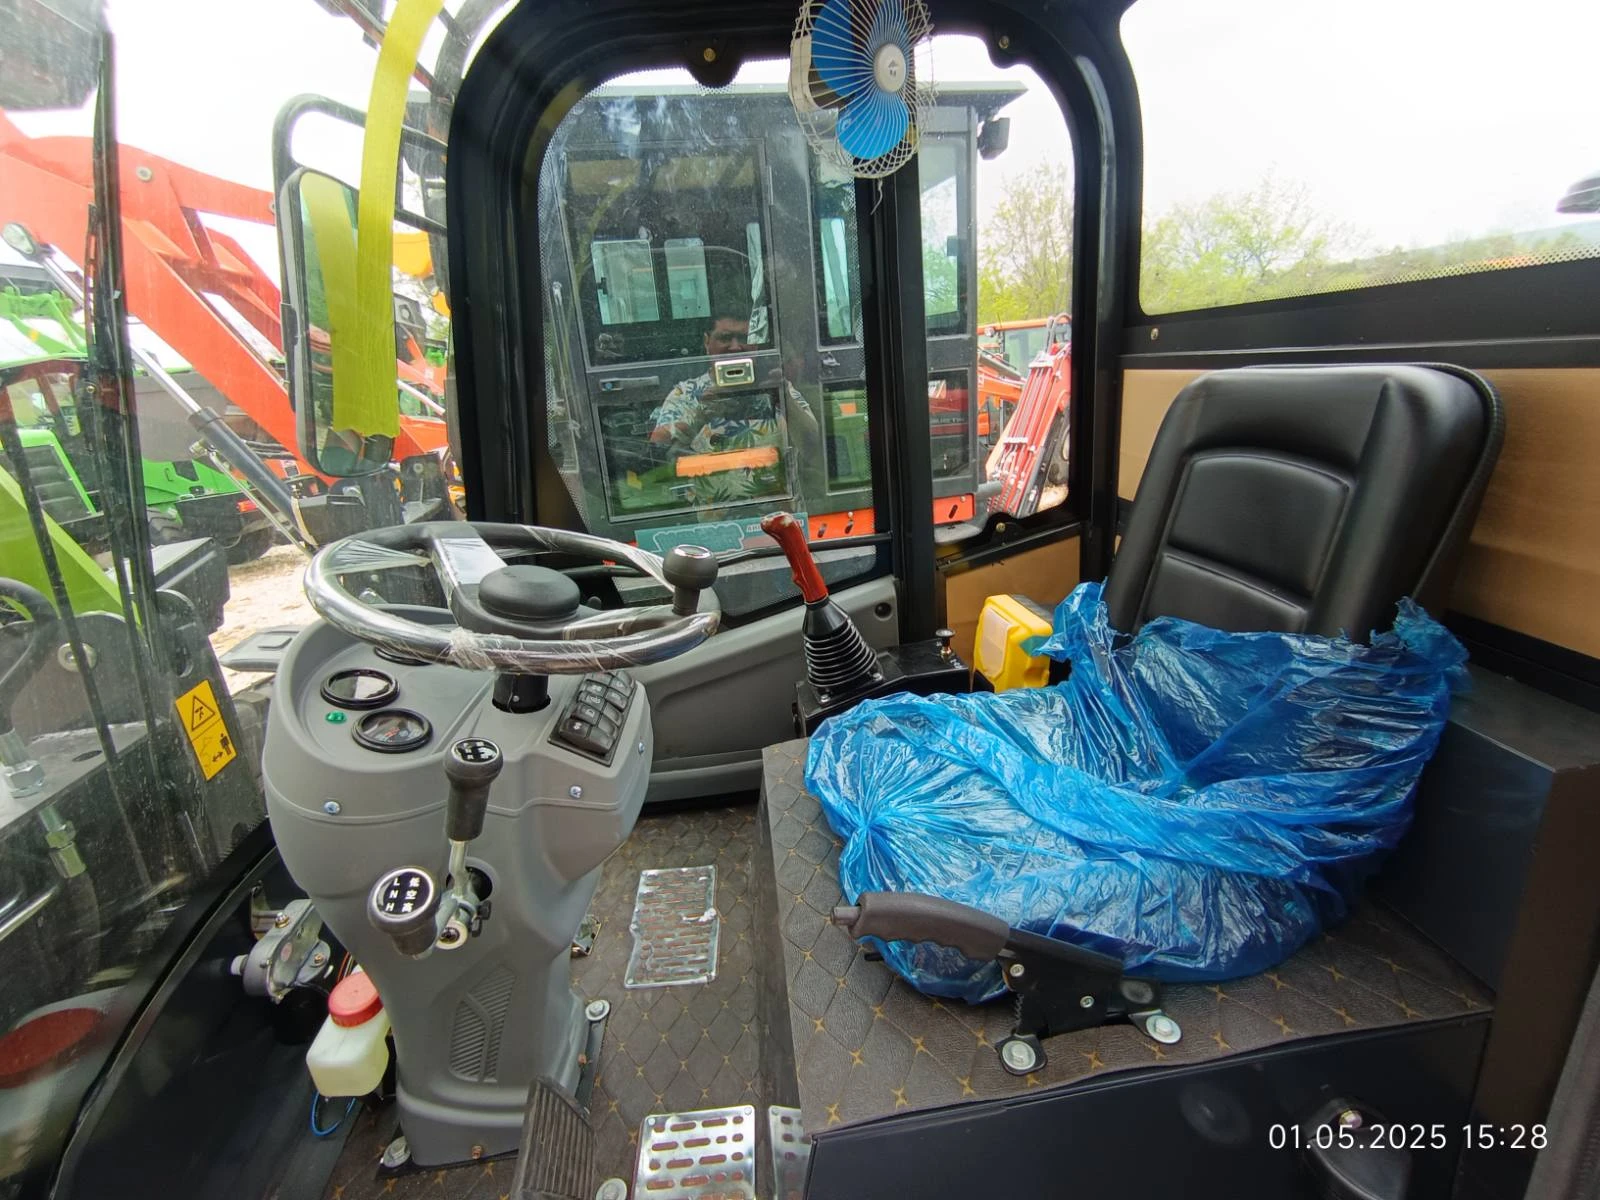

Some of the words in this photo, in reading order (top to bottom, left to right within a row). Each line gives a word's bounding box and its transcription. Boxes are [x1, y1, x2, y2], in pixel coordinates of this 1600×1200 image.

[393, 877, 400, 886] L
[389, 889, 399, 899] N
[405, 889, 417, 900] 空
[385, 902, 396, 912] H
